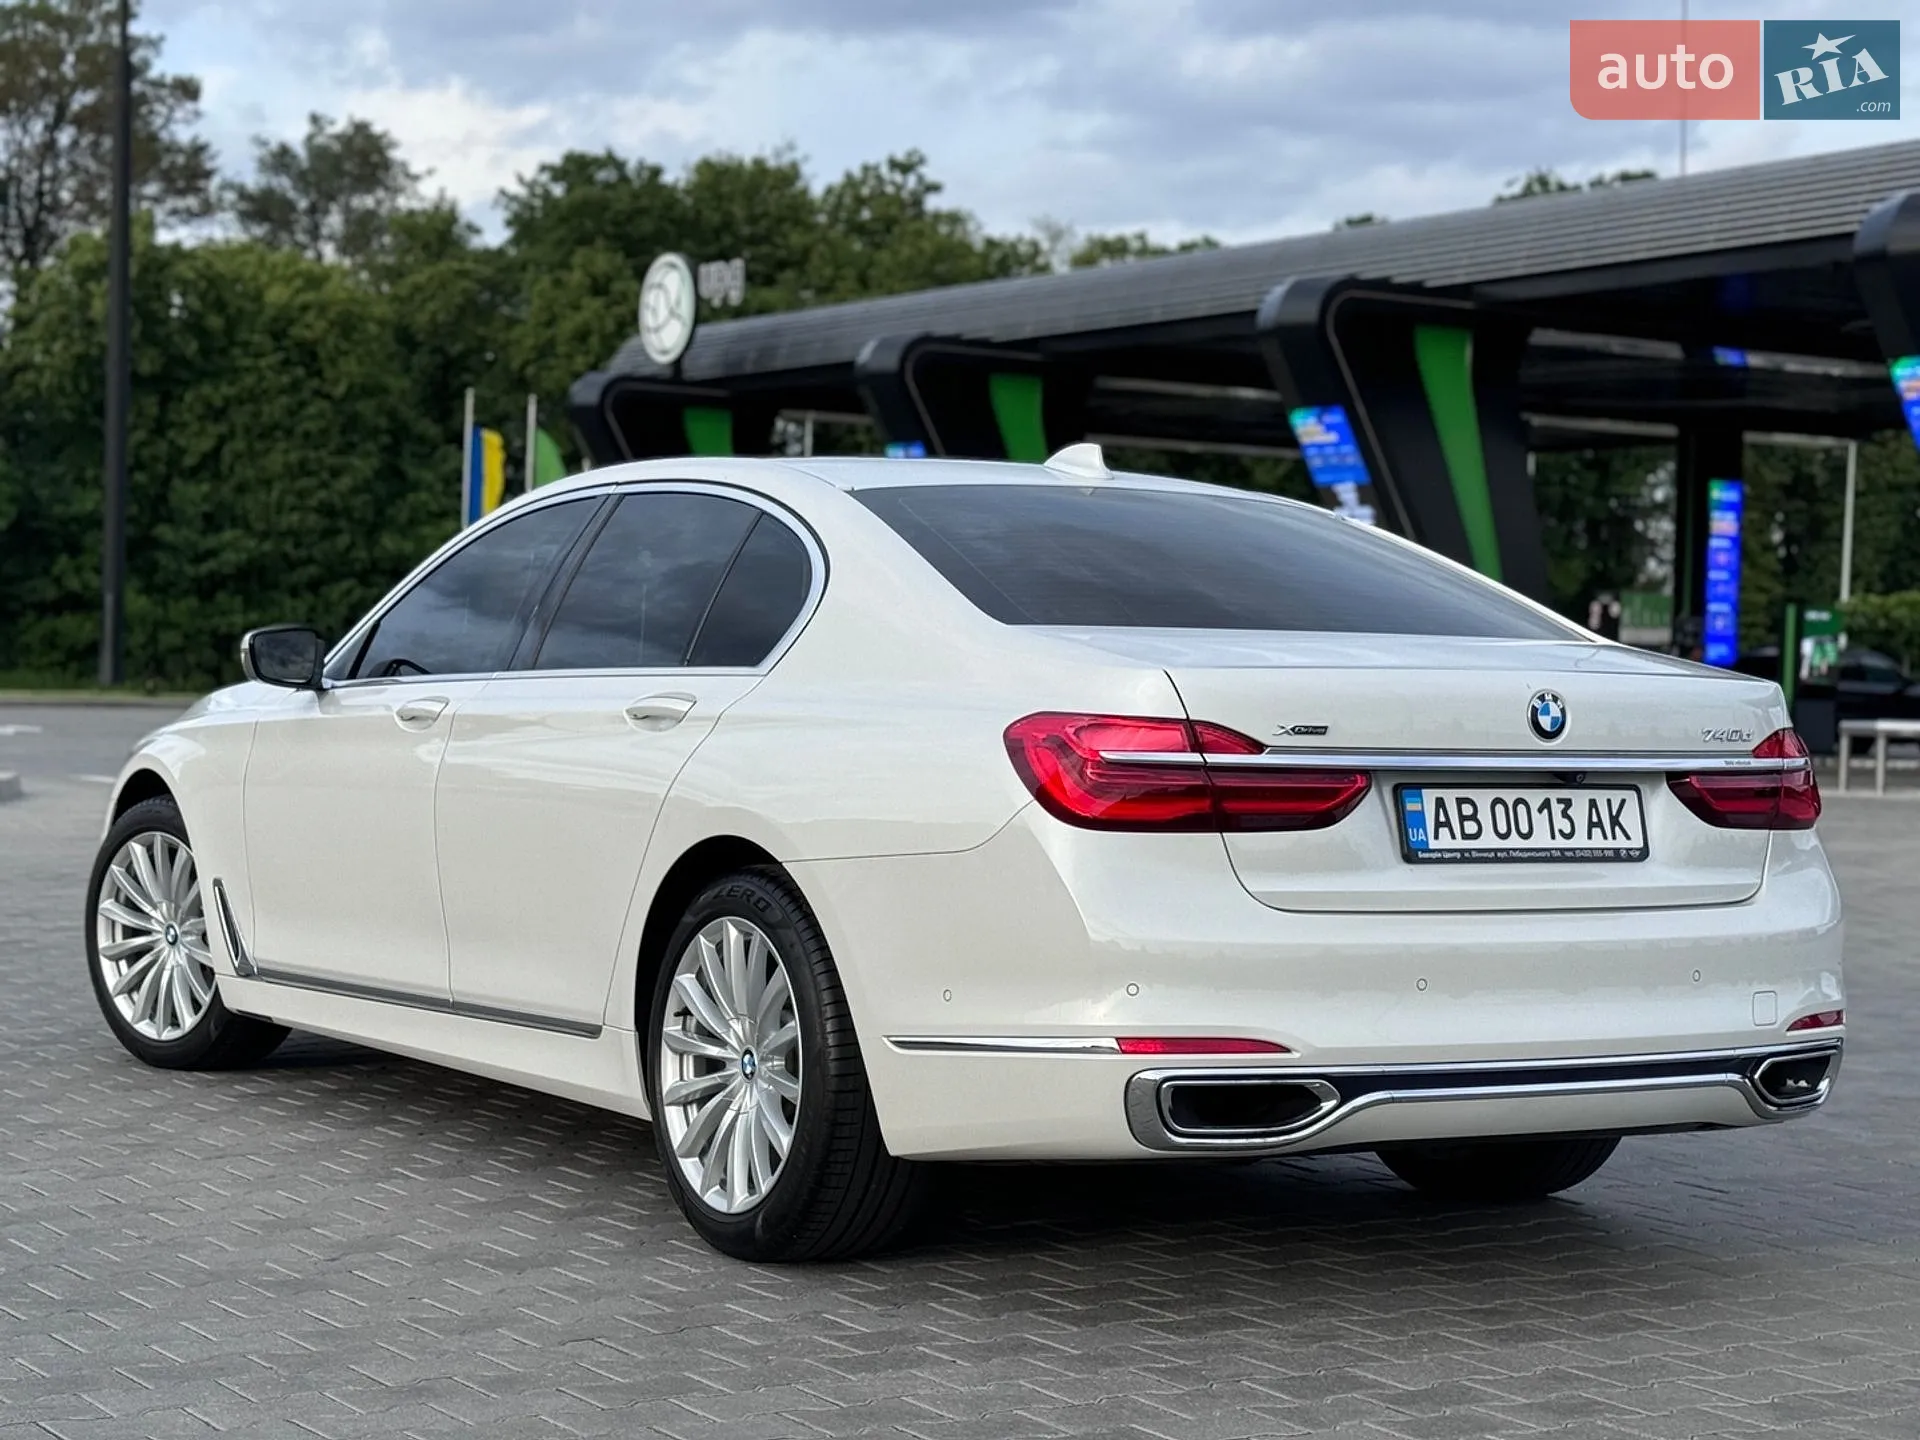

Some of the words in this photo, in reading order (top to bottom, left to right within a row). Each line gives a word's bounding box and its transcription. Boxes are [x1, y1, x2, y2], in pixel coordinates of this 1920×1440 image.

[1433, 796, 1483, 841] AB
[1490, 796, 1576, 841] 0013
[1587, 797, 1632, 841] AK
[1408, 827, 1428, 843] UA
